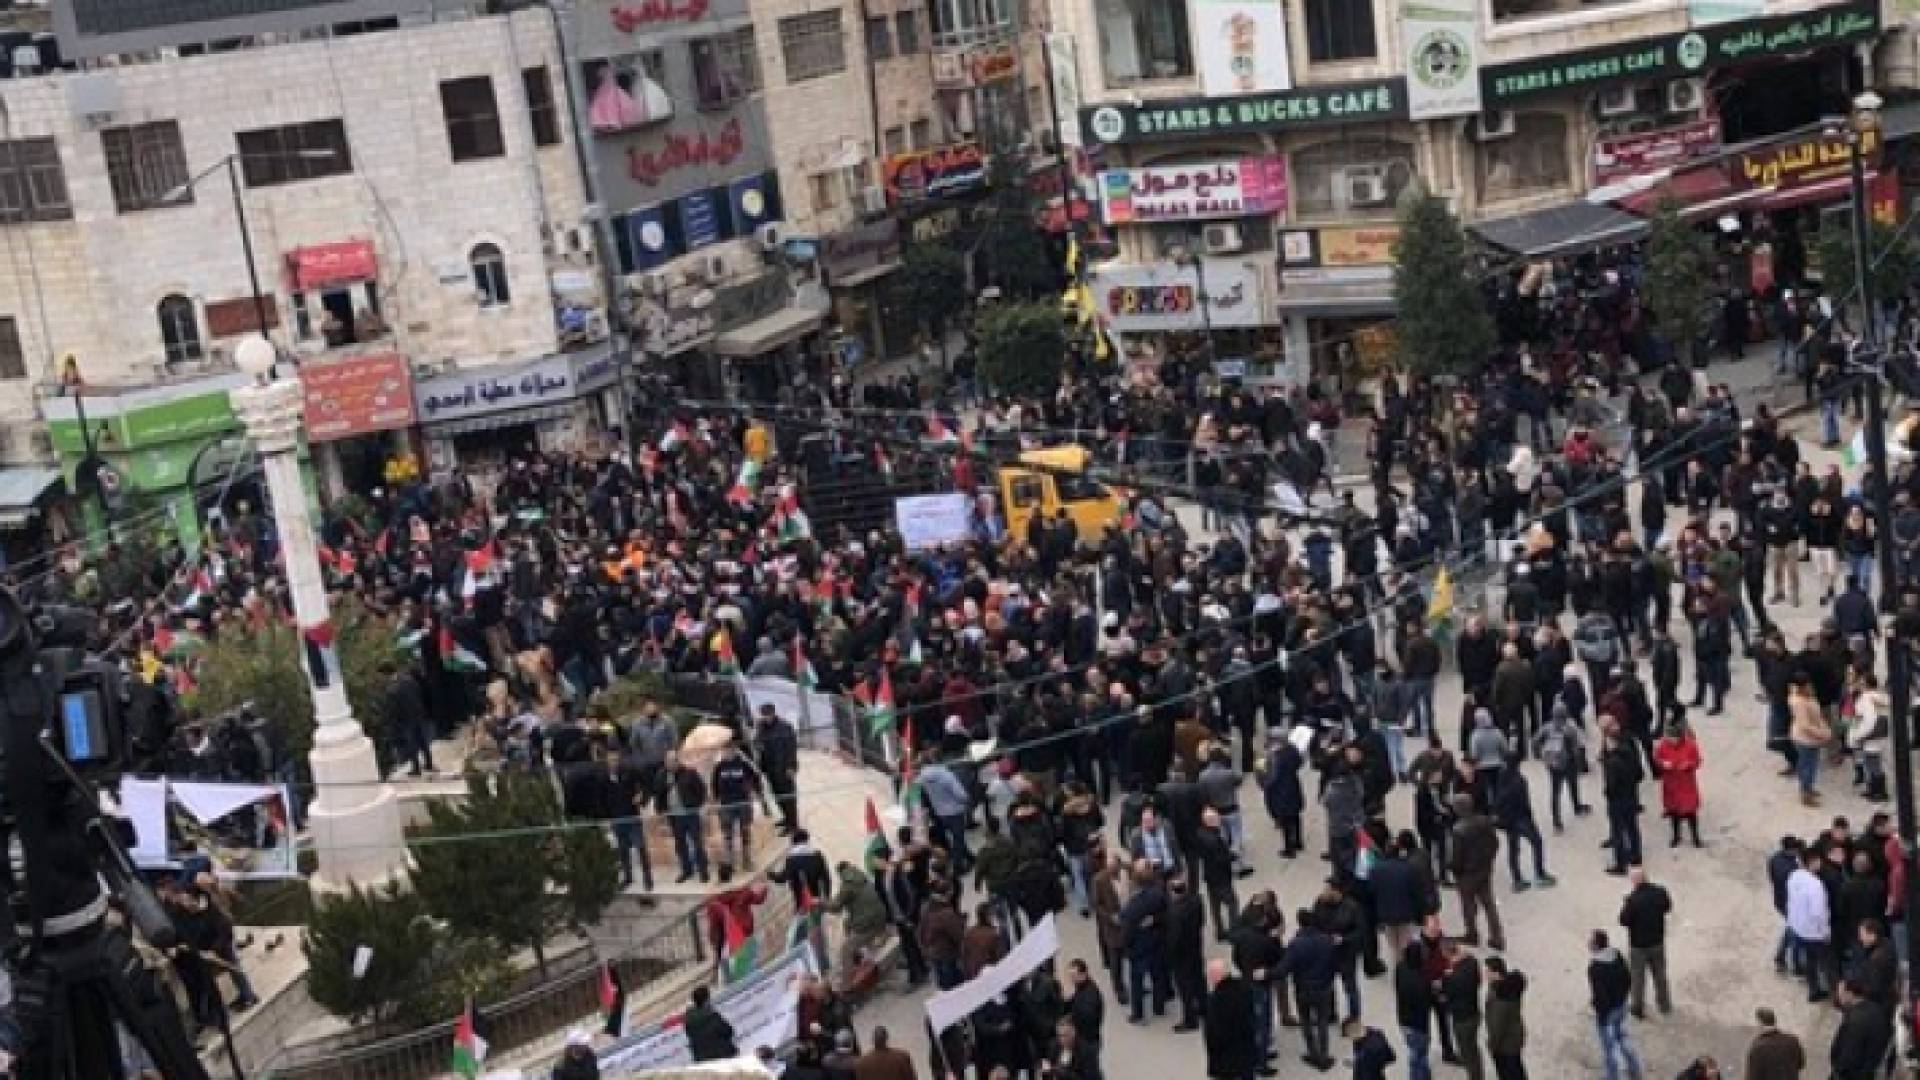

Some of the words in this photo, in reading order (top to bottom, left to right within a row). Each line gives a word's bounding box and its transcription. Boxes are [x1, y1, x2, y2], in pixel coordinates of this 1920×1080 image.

[1495, 71, 1547, 95] STARS
[1552, 66, 1562, 84] &
[1565, 58, 1620, 83] BUCKS
[1137, 109, 1211, 133] STARS
[1217, 105, 1232, 125] &
[1238, 96, 1321, 123] BUCKS
[1131, 170, 1189, 198] مول
